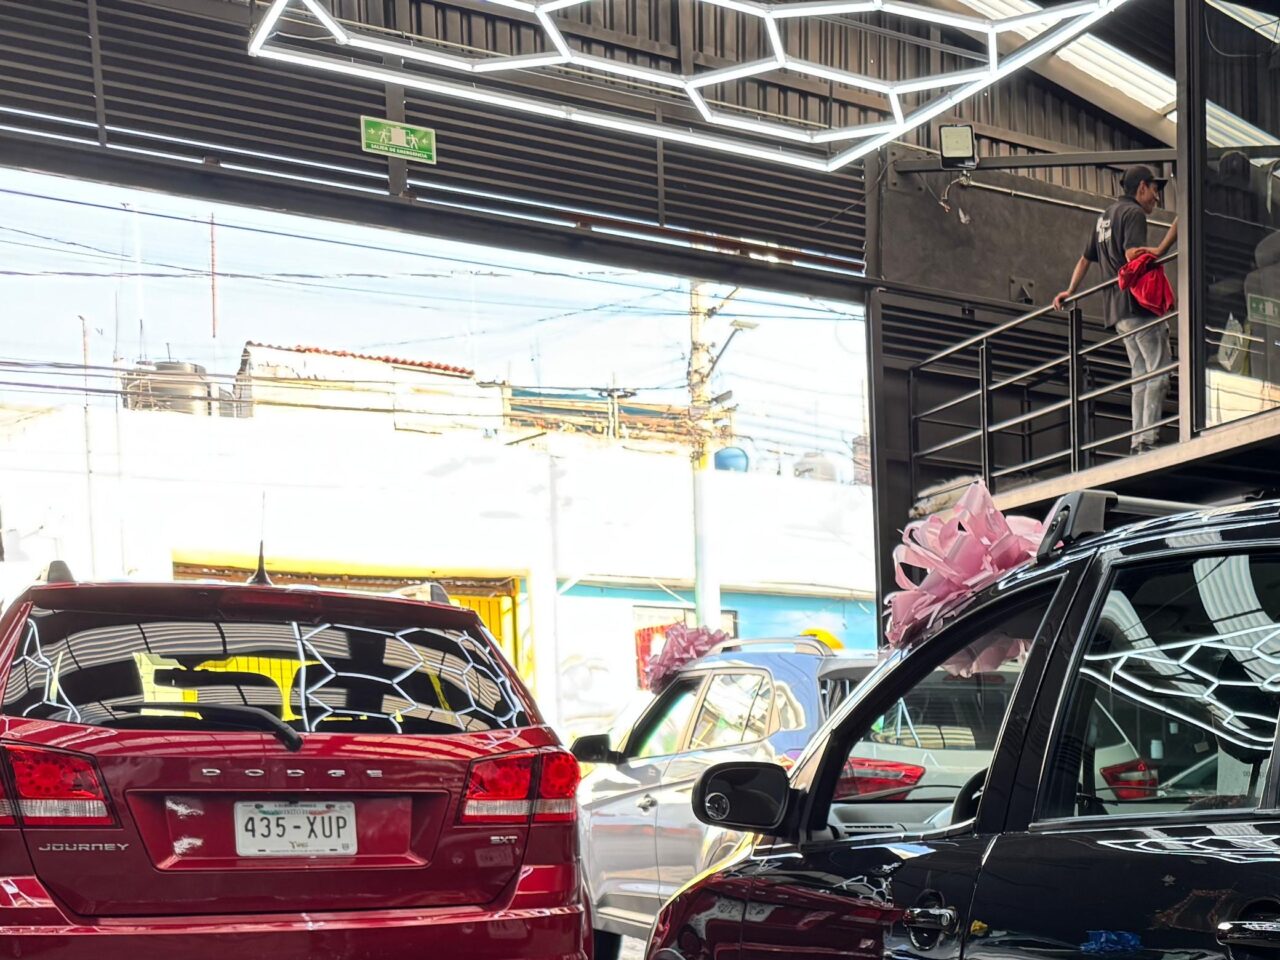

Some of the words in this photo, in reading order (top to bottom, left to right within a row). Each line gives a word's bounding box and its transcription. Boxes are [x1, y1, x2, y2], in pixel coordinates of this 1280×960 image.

[202, 768, 383, 778] DODGE
[244, 816, 347, 839] 435-XUP
[38, 842, 131, 852] JOURNEY
